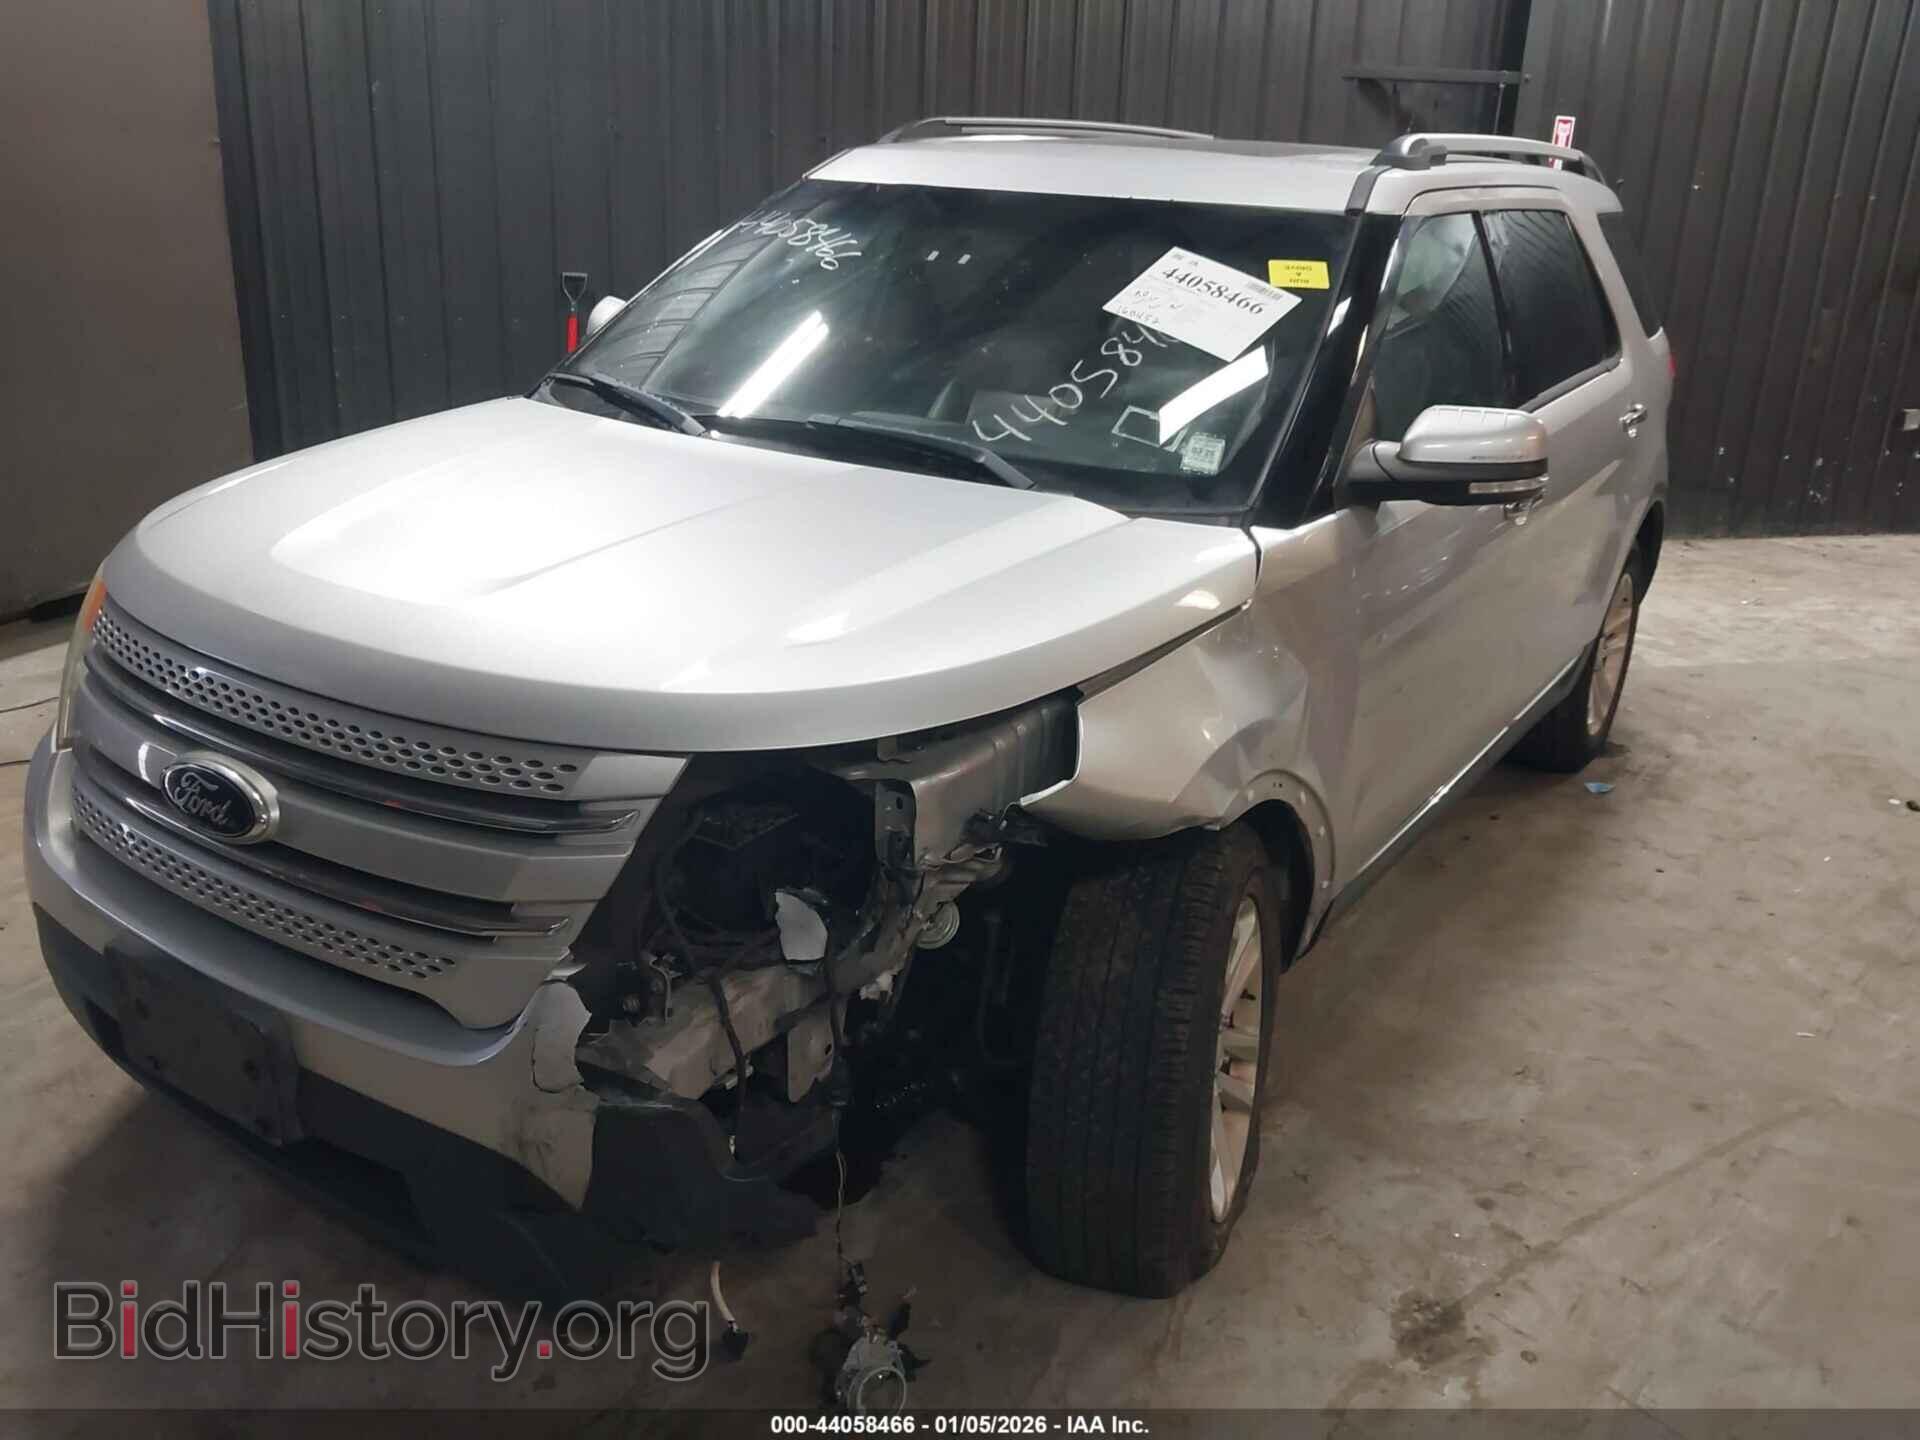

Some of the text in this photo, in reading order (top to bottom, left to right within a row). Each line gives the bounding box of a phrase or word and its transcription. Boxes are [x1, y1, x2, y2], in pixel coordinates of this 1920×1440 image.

[1162, 267, 1264, 315] 44058466
[972, 325, 1179, 441] 440584
[174, 771, 232, 825] Ford
